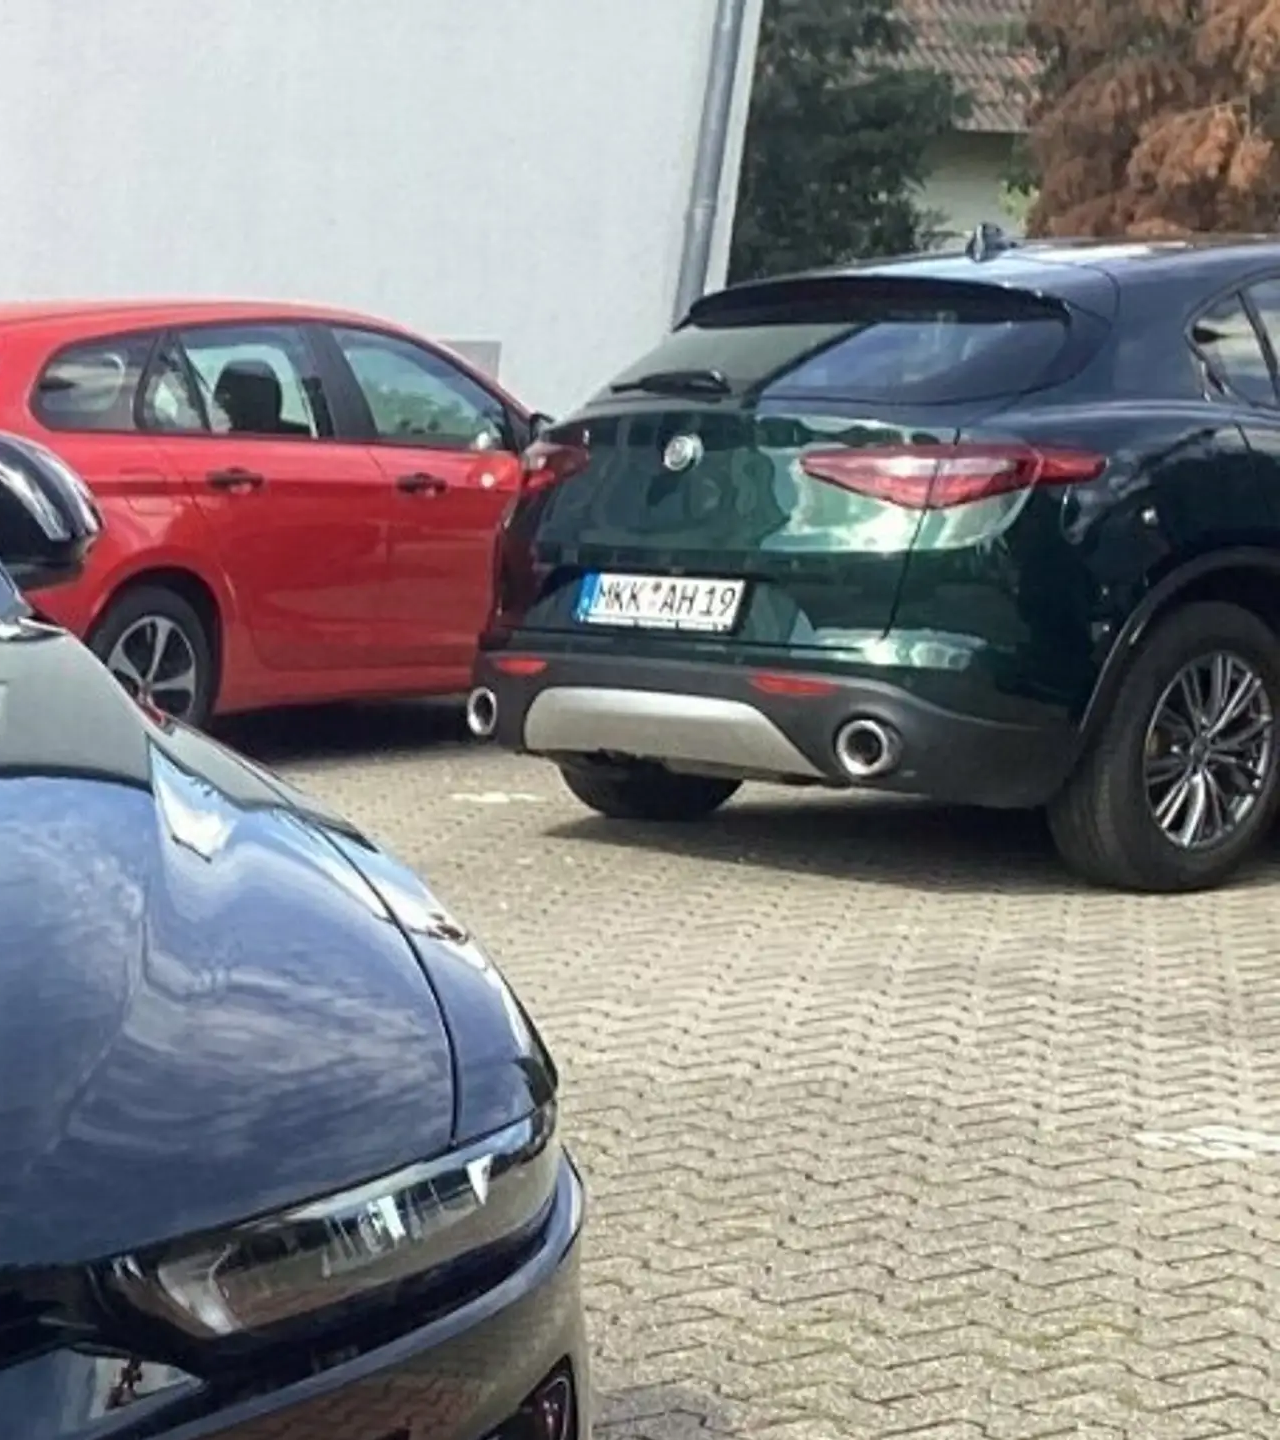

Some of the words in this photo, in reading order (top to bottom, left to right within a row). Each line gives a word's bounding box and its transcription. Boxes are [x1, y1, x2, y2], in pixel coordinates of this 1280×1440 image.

[594, 580, 647, 612] MKK
[659, 583, 698, 616] AH
[699, 586, 736, 617] 19
